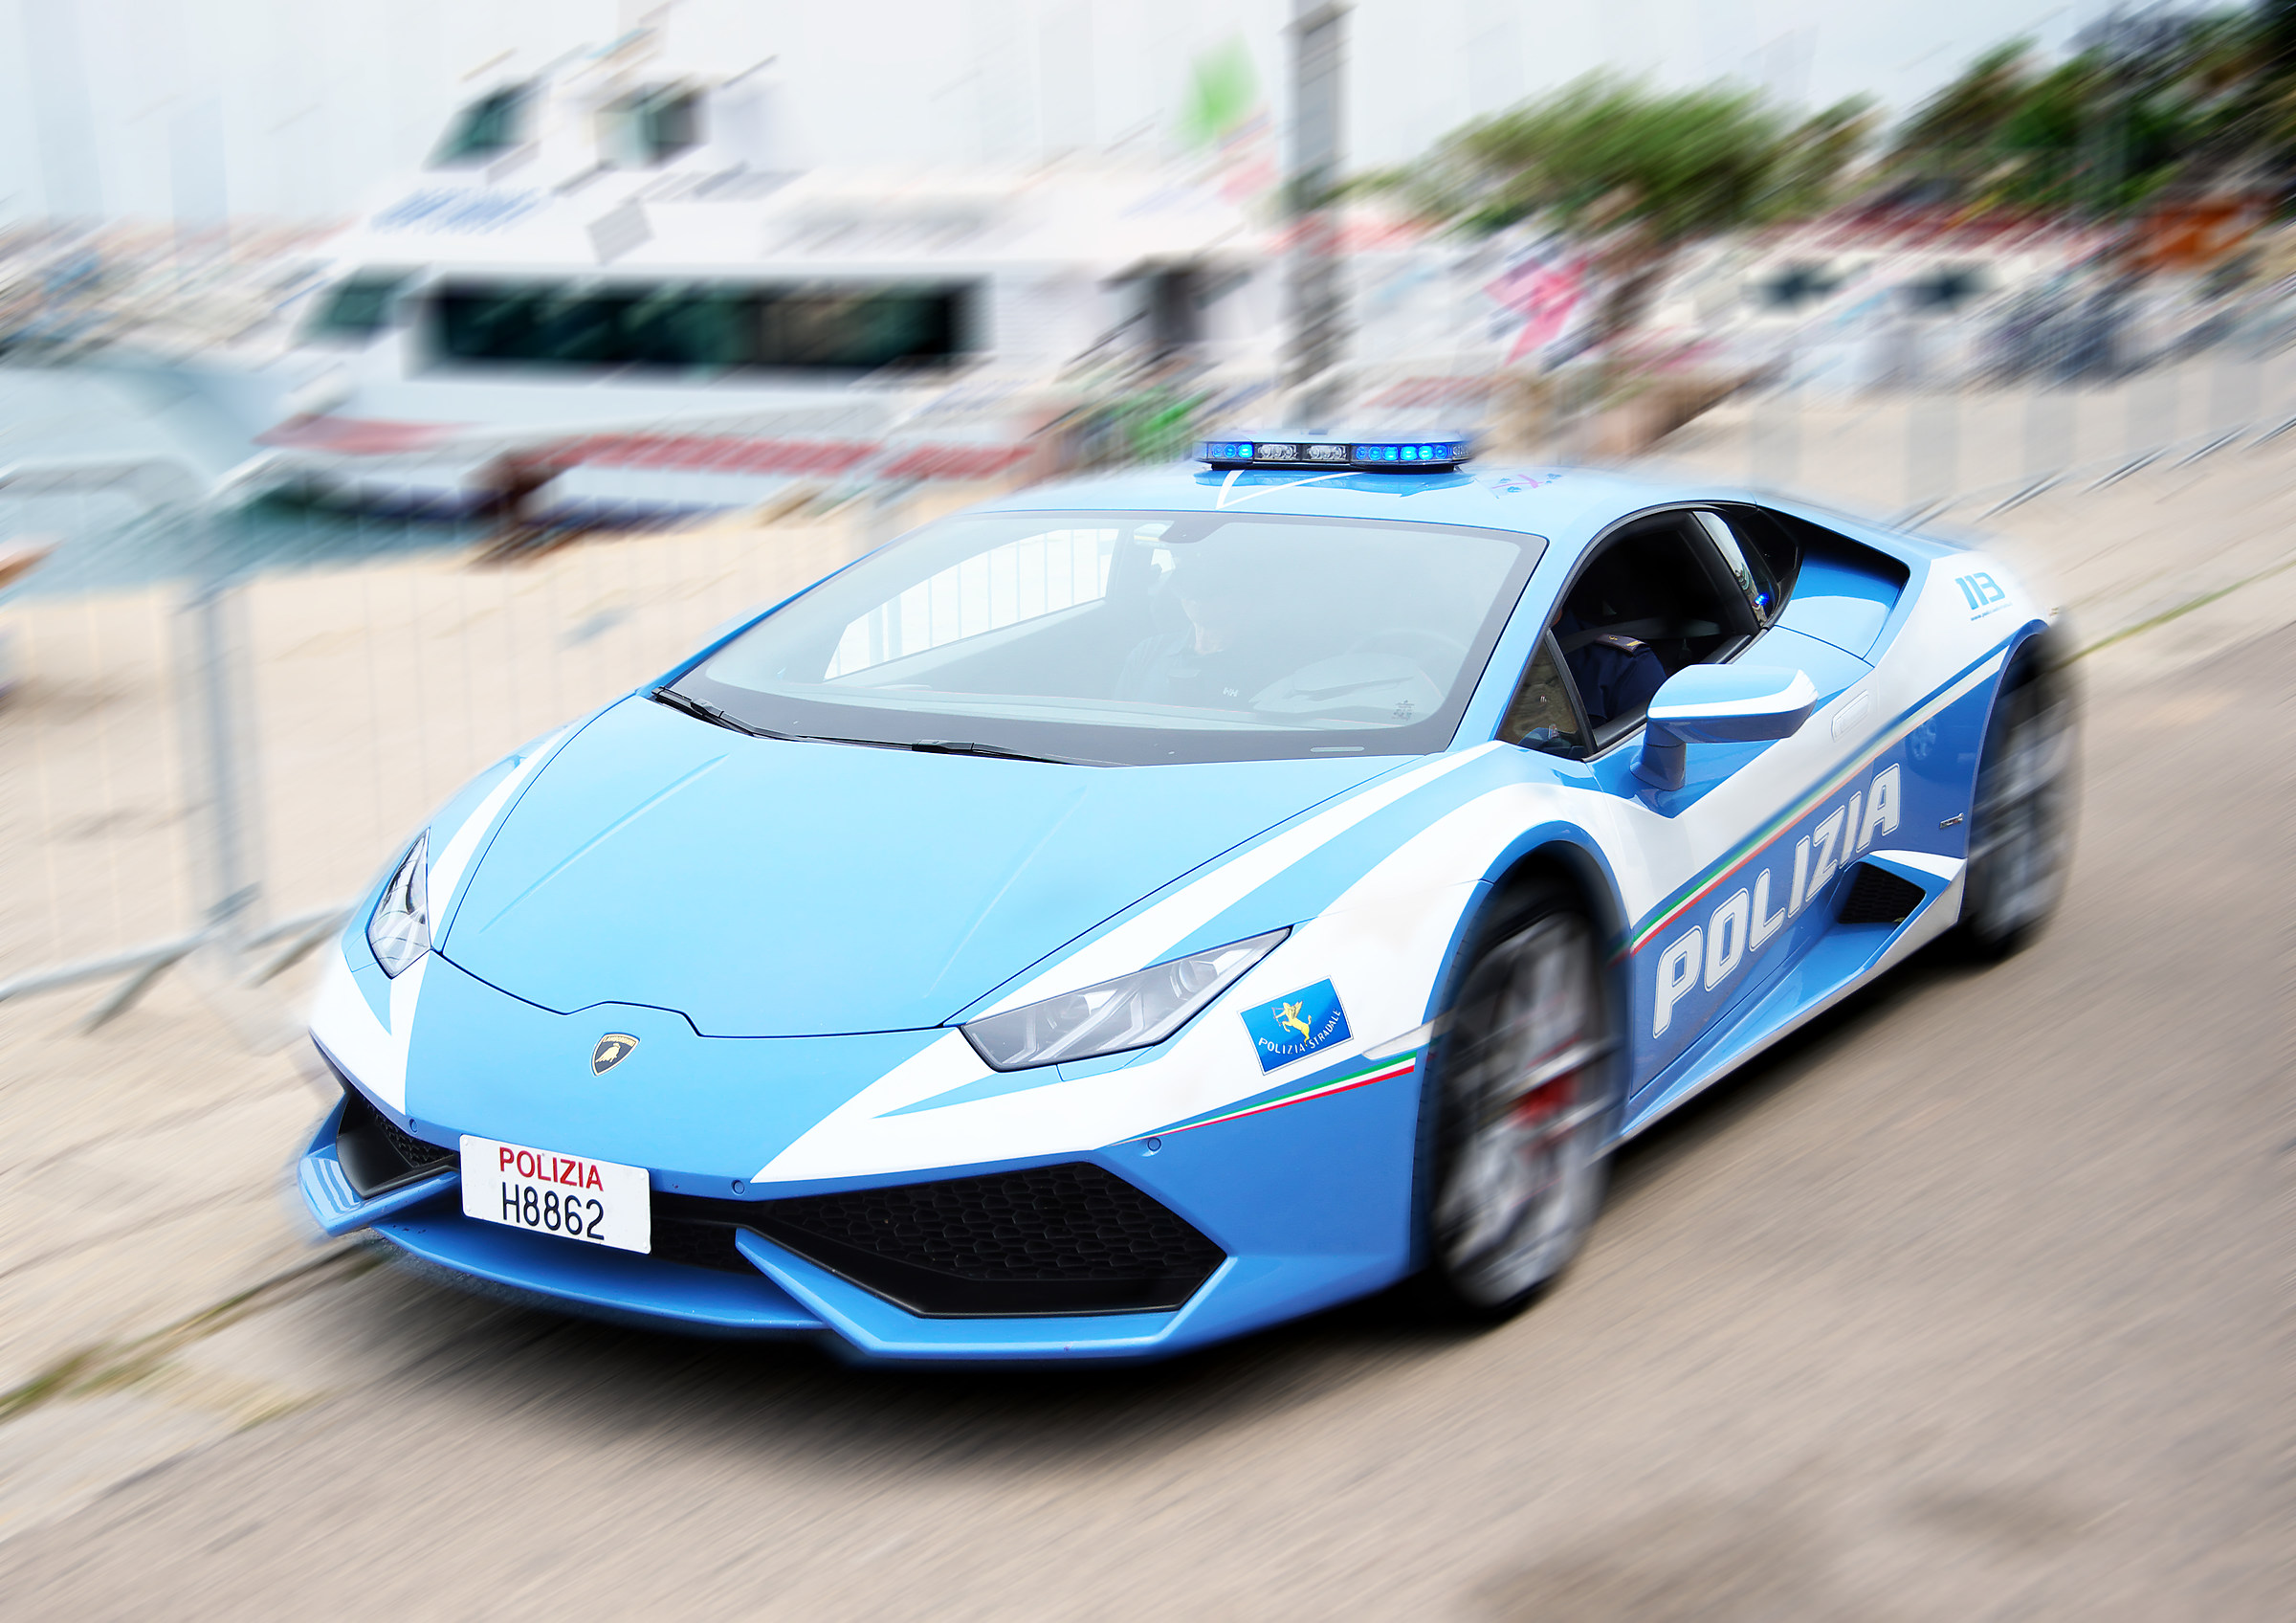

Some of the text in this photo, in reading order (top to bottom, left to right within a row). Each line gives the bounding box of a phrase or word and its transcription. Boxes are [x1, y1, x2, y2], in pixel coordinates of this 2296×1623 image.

[1954, 571, 2005, 610] 113
[1652, 763, 1901, 1038] POLIZIA
[1258, 1008, 1341, 1055] POLIZIA STRADALE
[499, 1146, 604, 1191] POLIZIA
[502, 1181, 605, 1240] H8862
